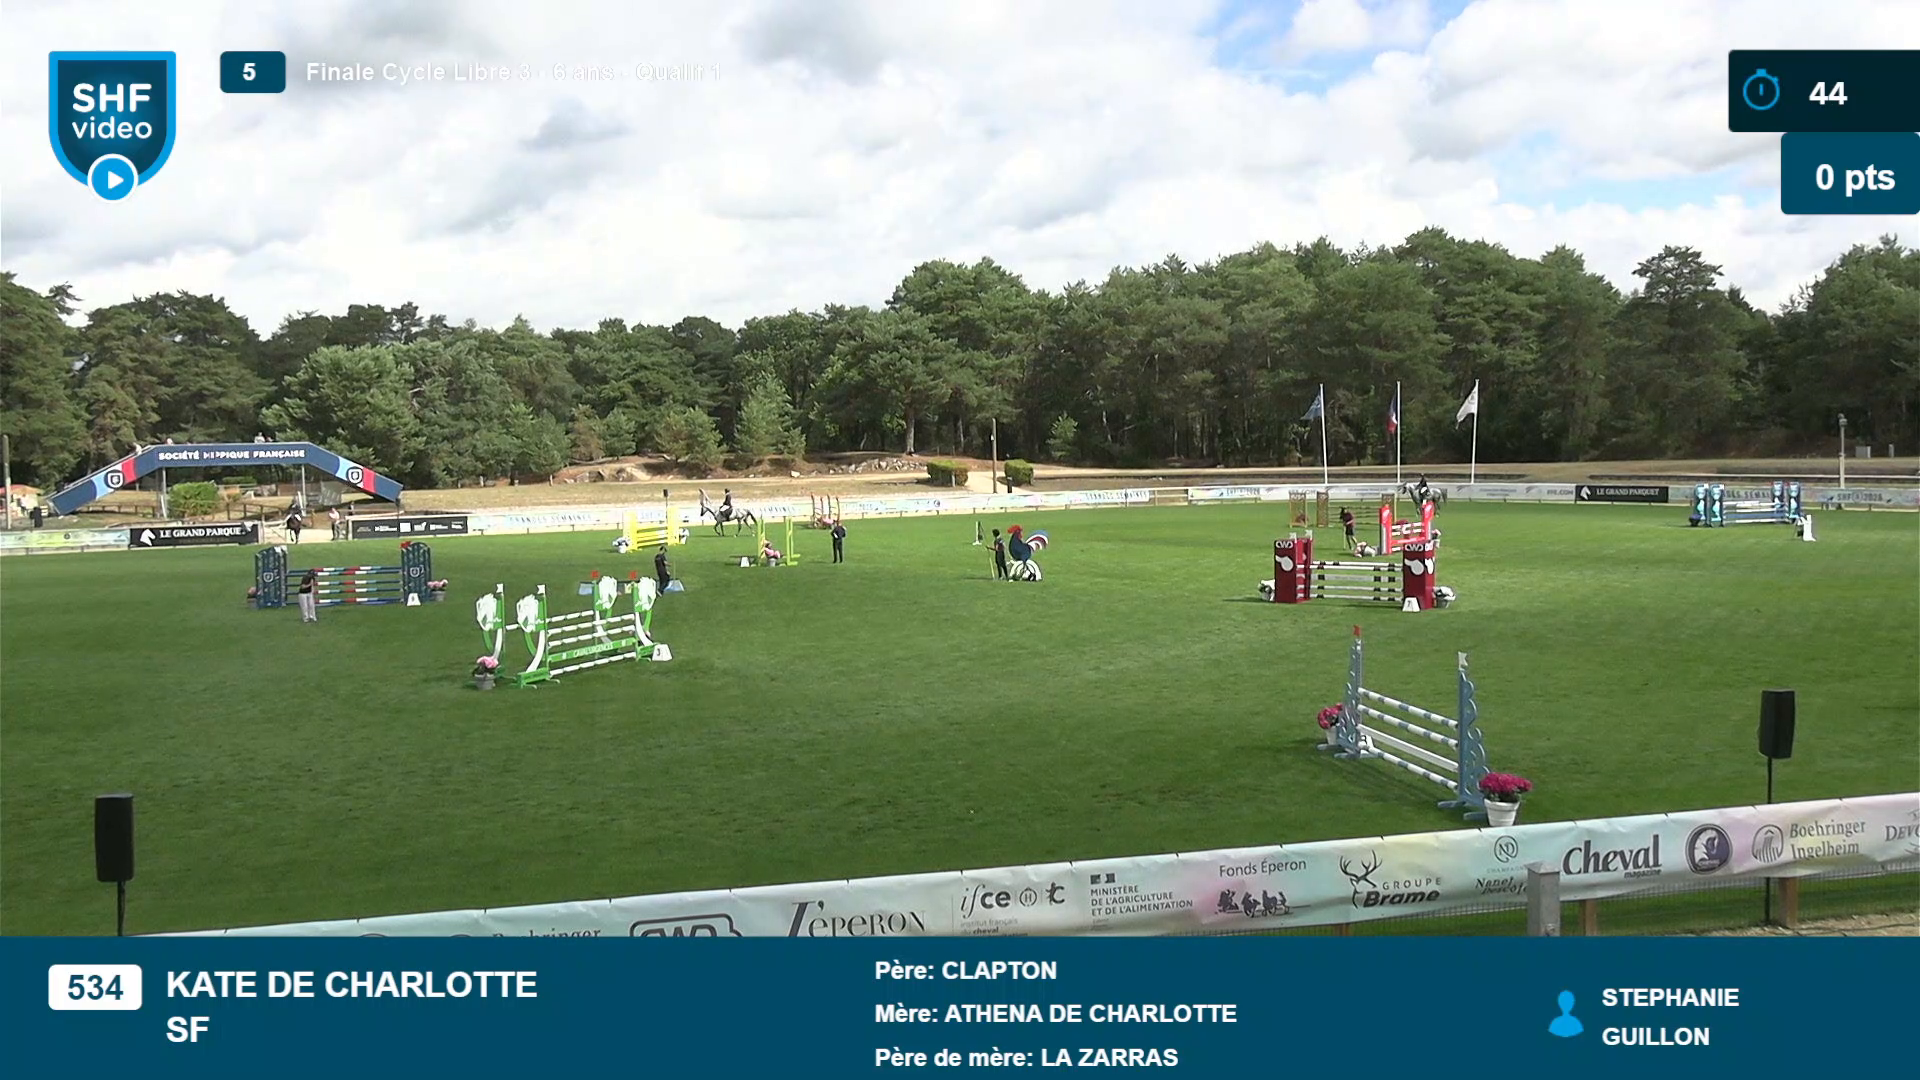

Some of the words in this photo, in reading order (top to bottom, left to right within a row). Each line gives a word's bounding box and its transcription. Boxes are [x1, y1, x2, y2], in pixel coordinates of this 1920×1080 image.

[158, 450, 200, 460] SOCIÉTÉ
[253, 449, 305, 460] FRANÇAISE
[1596, 488, 1605, 496] LE
[1605, 488, 1628, 496] GRAND
[1629, 487, 1659, 497] PARQUET
[160, 529, 172, 538] LE
[172, 527, 205, 538] GRAND
[206, 526, 245, 537] PARQUE
[1275, 540, 1294, 549] CWD
[1404, 542, 1424, 552] CWD
[1789, 819, 1866, 839] Boehringer
[1562, 833, 1662, 876] Cheval
[1790, 839, 1859, 860] Ingelheim
[1219, 861, 1257, 877] Fonds
[1261, 856, 1307, 875] Éperon
[1623, 868, 1661, 879] magazine
[1090, 885, 1139, 896] MINISTÈRE
[1382, 877, 1441, 891] GROUPE
[960, 884, 1012, 919] ifce
[1091, 898, 1103, 907] DE
[1106, 891, 1173, 906] L'AGRICULTURE
[1363, 890, 1440, 908] Brame
[1091, 908, 1103, 917] ET
[1105, 906, 1117, 916] DE
[1119, 899, 1193, 914] L'ALIMENTATION
